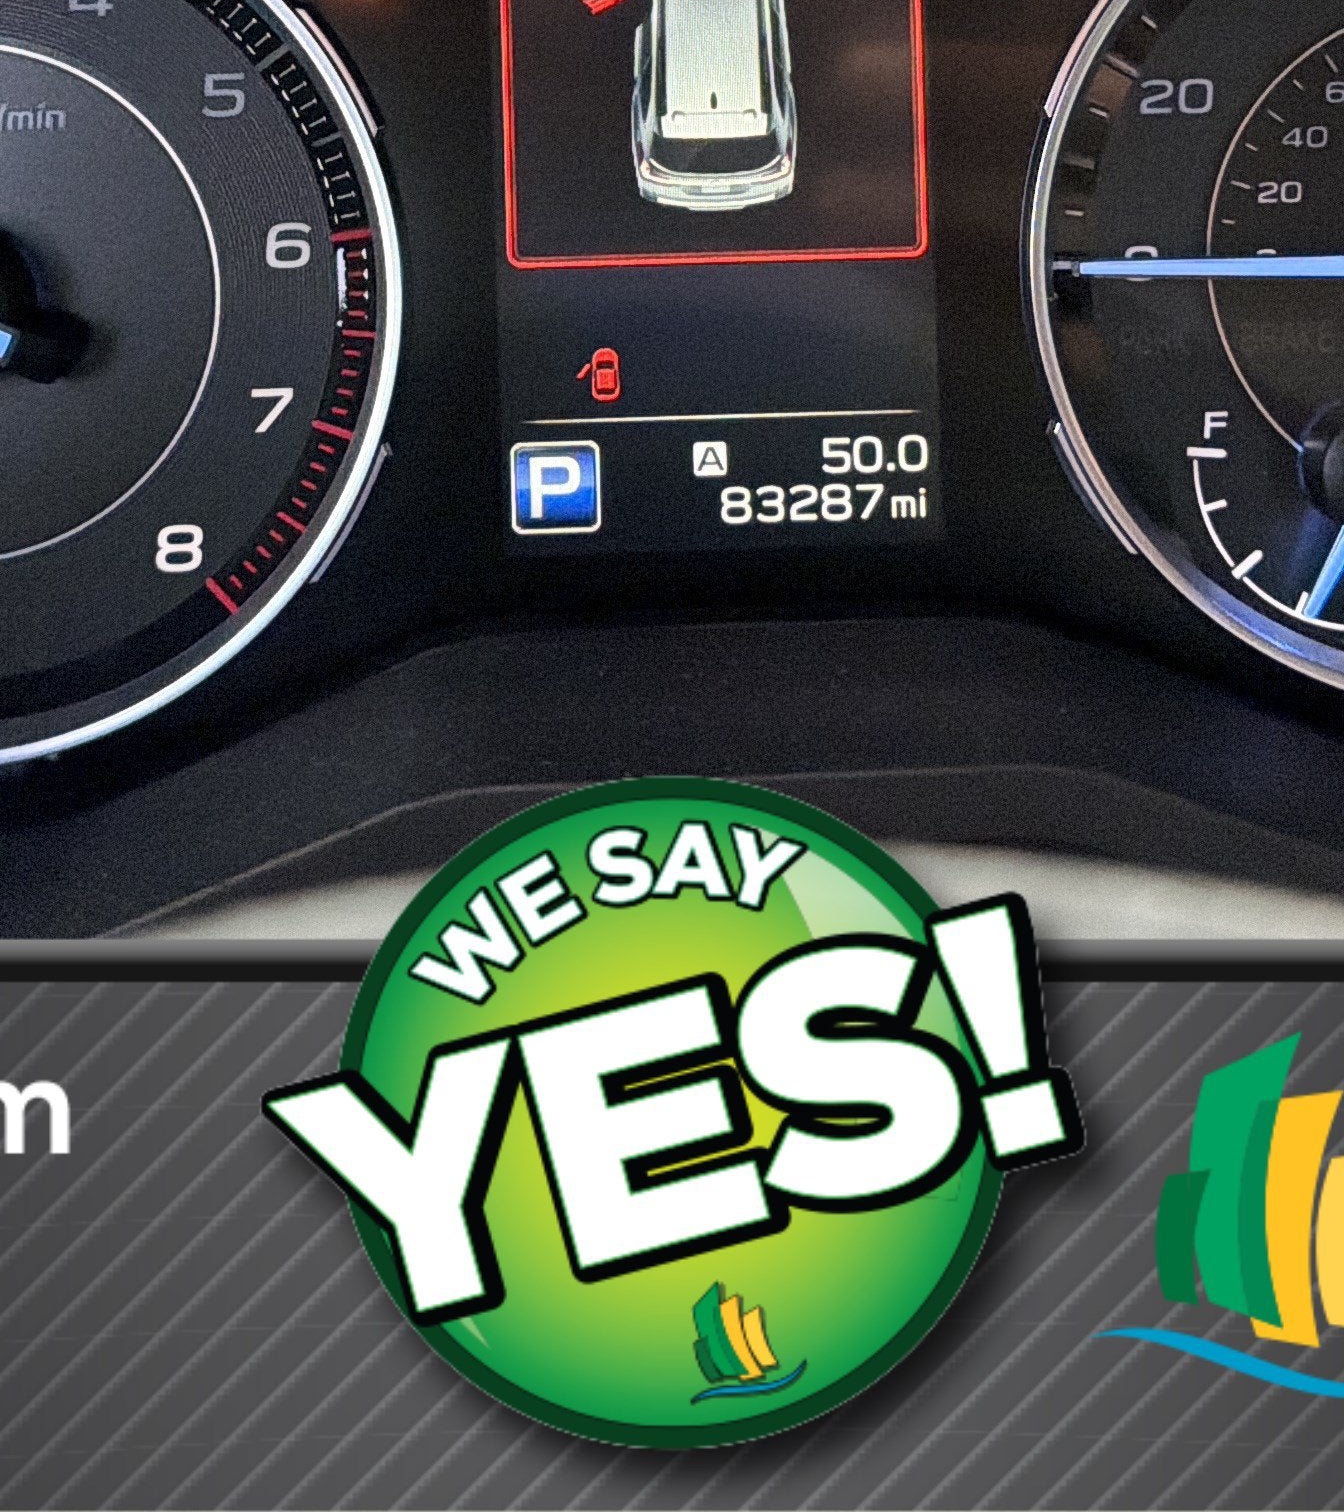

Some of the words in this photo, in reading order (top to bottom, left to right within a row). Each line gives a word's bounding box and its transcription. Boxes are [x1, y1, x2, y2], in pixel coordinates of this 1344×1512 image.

[203, 73, 245, 117] 5
[1140, 78, 1213, 114] 20
[1282, 126, 1328, 148] 40
[1258, 181, 1302, 204] 20
[266, 223, 310, 268] 6
[251, 388, 293, 432] 7
[1203, 410, 1229, 440] F
[695, 444, 726, 474] A
[822, 434, 928, 474] 50.0
[528, 455, 582, 519] P
[721, 483, 884, 524] 83287
[891, 487, 926, 518] mi
[156, 525, 203, 572] 8
